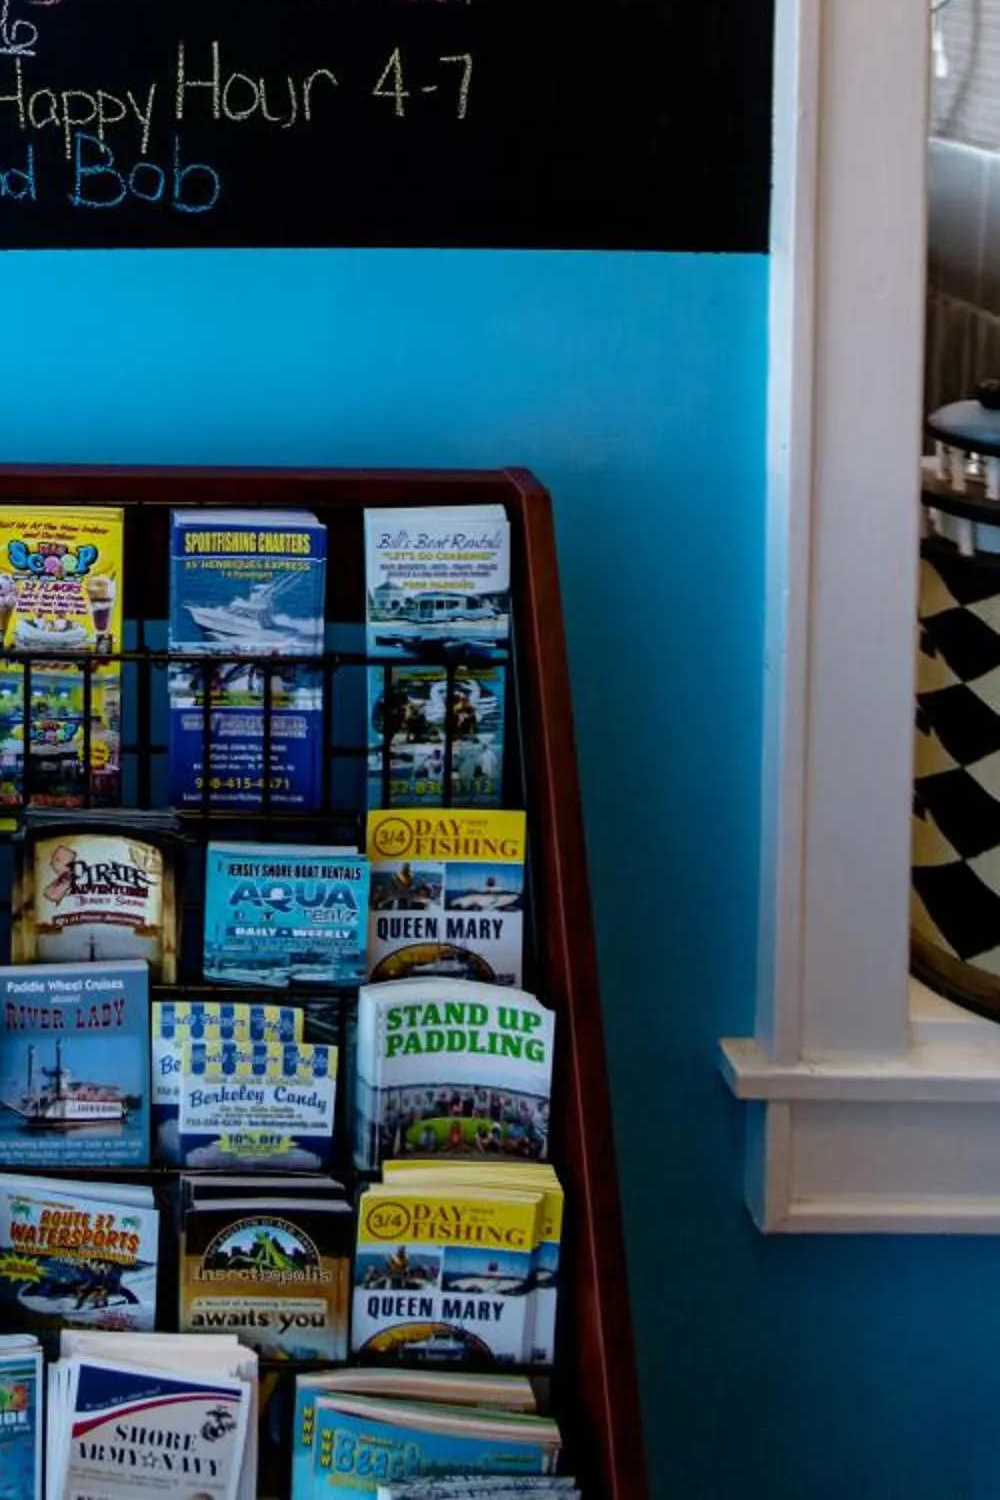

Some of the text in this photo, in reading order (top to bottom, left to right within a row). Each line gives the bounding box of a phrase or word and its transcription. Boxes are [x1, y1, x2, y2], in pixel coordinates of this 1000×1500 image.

[175, 40, 338, 129] Hour
[371, 47, 474, 120] 4-7
[67, 131, 221, 213] Bob
[184, 531, 311, 555] SPORTFISHING CHARTERS
[379, 828, 406, 846] 3/4
[415, 818, 463, 836] DAY
[414, 837, 519, 858] FISHING
[65, 859, 157, 887] PIRATE
[227, 864, 362, 881] JERSEY SHORE BOAT RENTALS
[229, 880, 359, 913] AQUA
[377, 917, 504, 941] QUEEN MARY
[6, 997, 124, 1029] RIVER LADY
[387, 1001, 542, 1034] STAND UP
[385, 1029, 546, 1063] PADDLING
[189, 1084, 328, 1114] Berkeley Candy
[414, 1203, 462, 1222] DAY
[10, 1220, 140, 1254] WATERSPORTS
[412, 1221, 526, 1247] FISHING
[191, 1309, 326, 1335] awaits you
[367, 1296, 505, 1321] QUEEN MARY
[115, 1423, 198, 1452] SHORE
